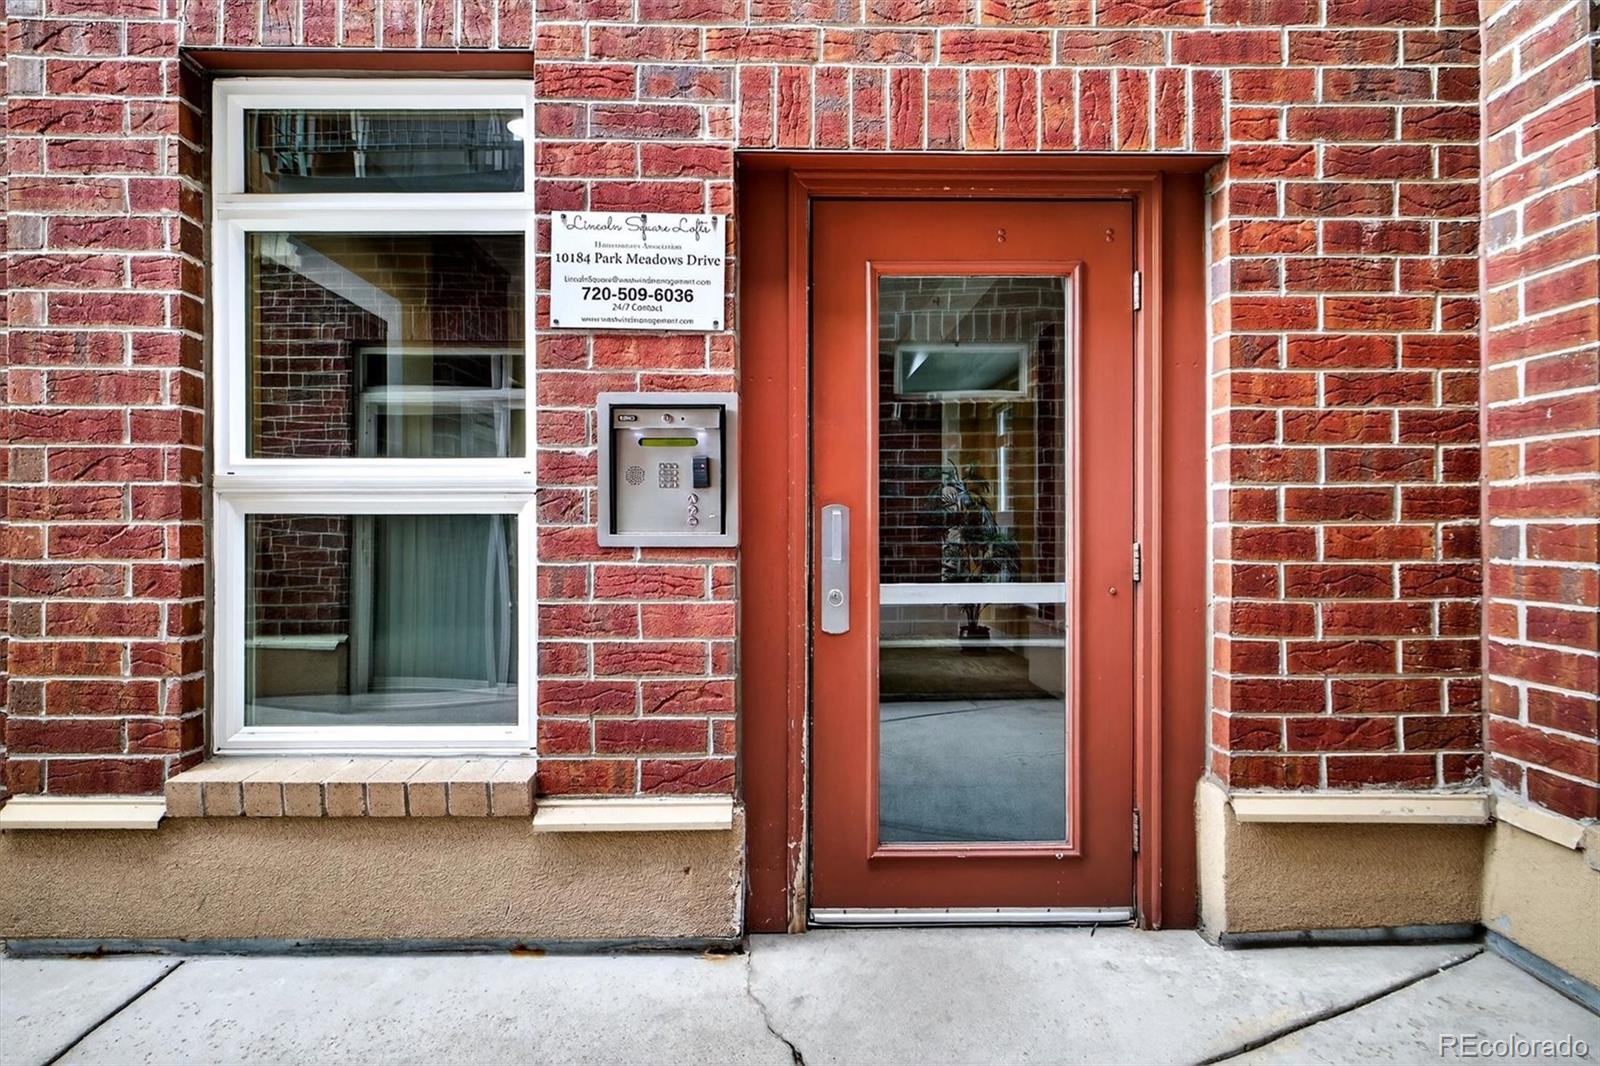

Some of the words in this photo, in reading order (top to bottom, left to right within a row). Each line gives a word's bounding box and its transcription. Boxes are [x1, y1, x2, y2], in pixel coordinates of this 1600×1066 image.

[567, 214, 622, 233] Lincoln
[625, 215, 670, 241] Square
[672, 217, 711, 242] Lofts
[556, 252, 591, 264] 10184
[594, 253, 623, 265] Park
[626, 253, 684, 266] Meadows
[687, 254, 721, 267] Drive
[581, 287, 694, 303] 720-509-6036
[612, 303, 630, 312] 24/7
[631, 303, 663, 313] Contact
